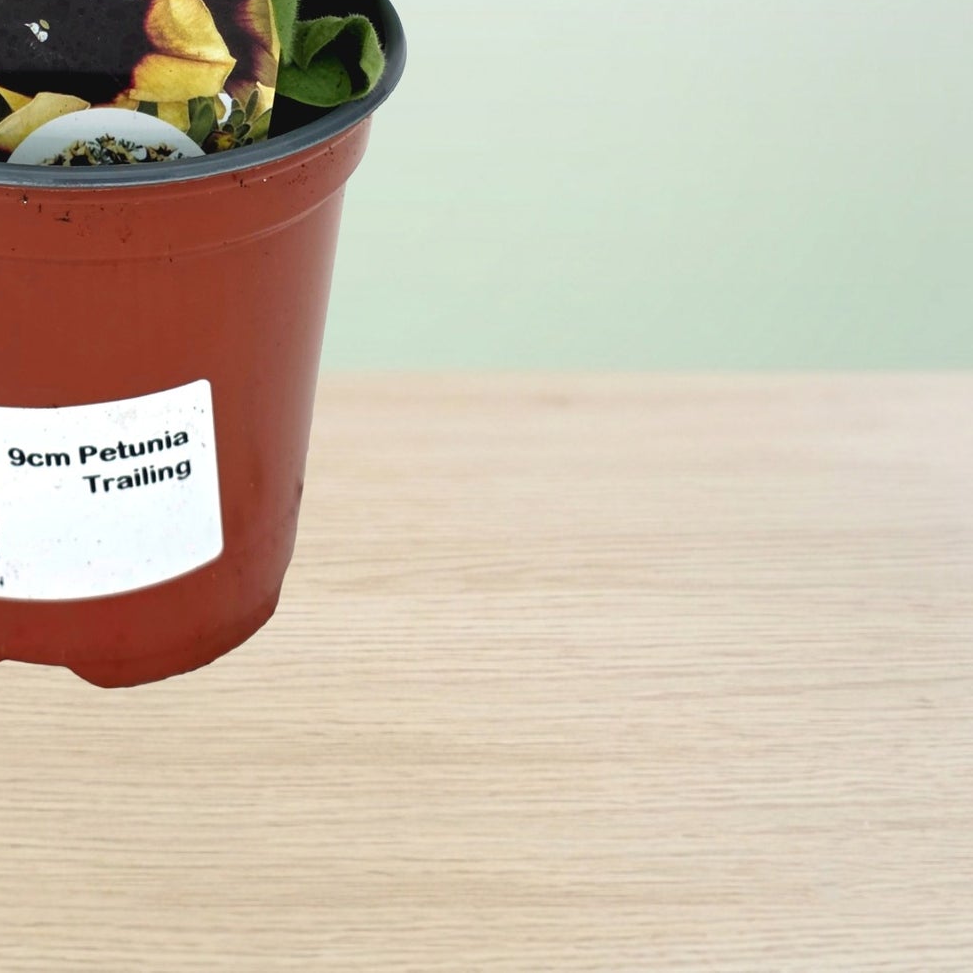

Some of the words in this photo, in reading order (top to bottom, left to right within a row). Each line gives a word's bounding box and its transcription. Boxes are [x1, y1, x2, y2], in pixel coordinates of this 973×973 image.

[7, 446, 71, 467] 9cm
[78, 430, 189, 465] Petunia
[83, 459, 192, 494] Trailing
